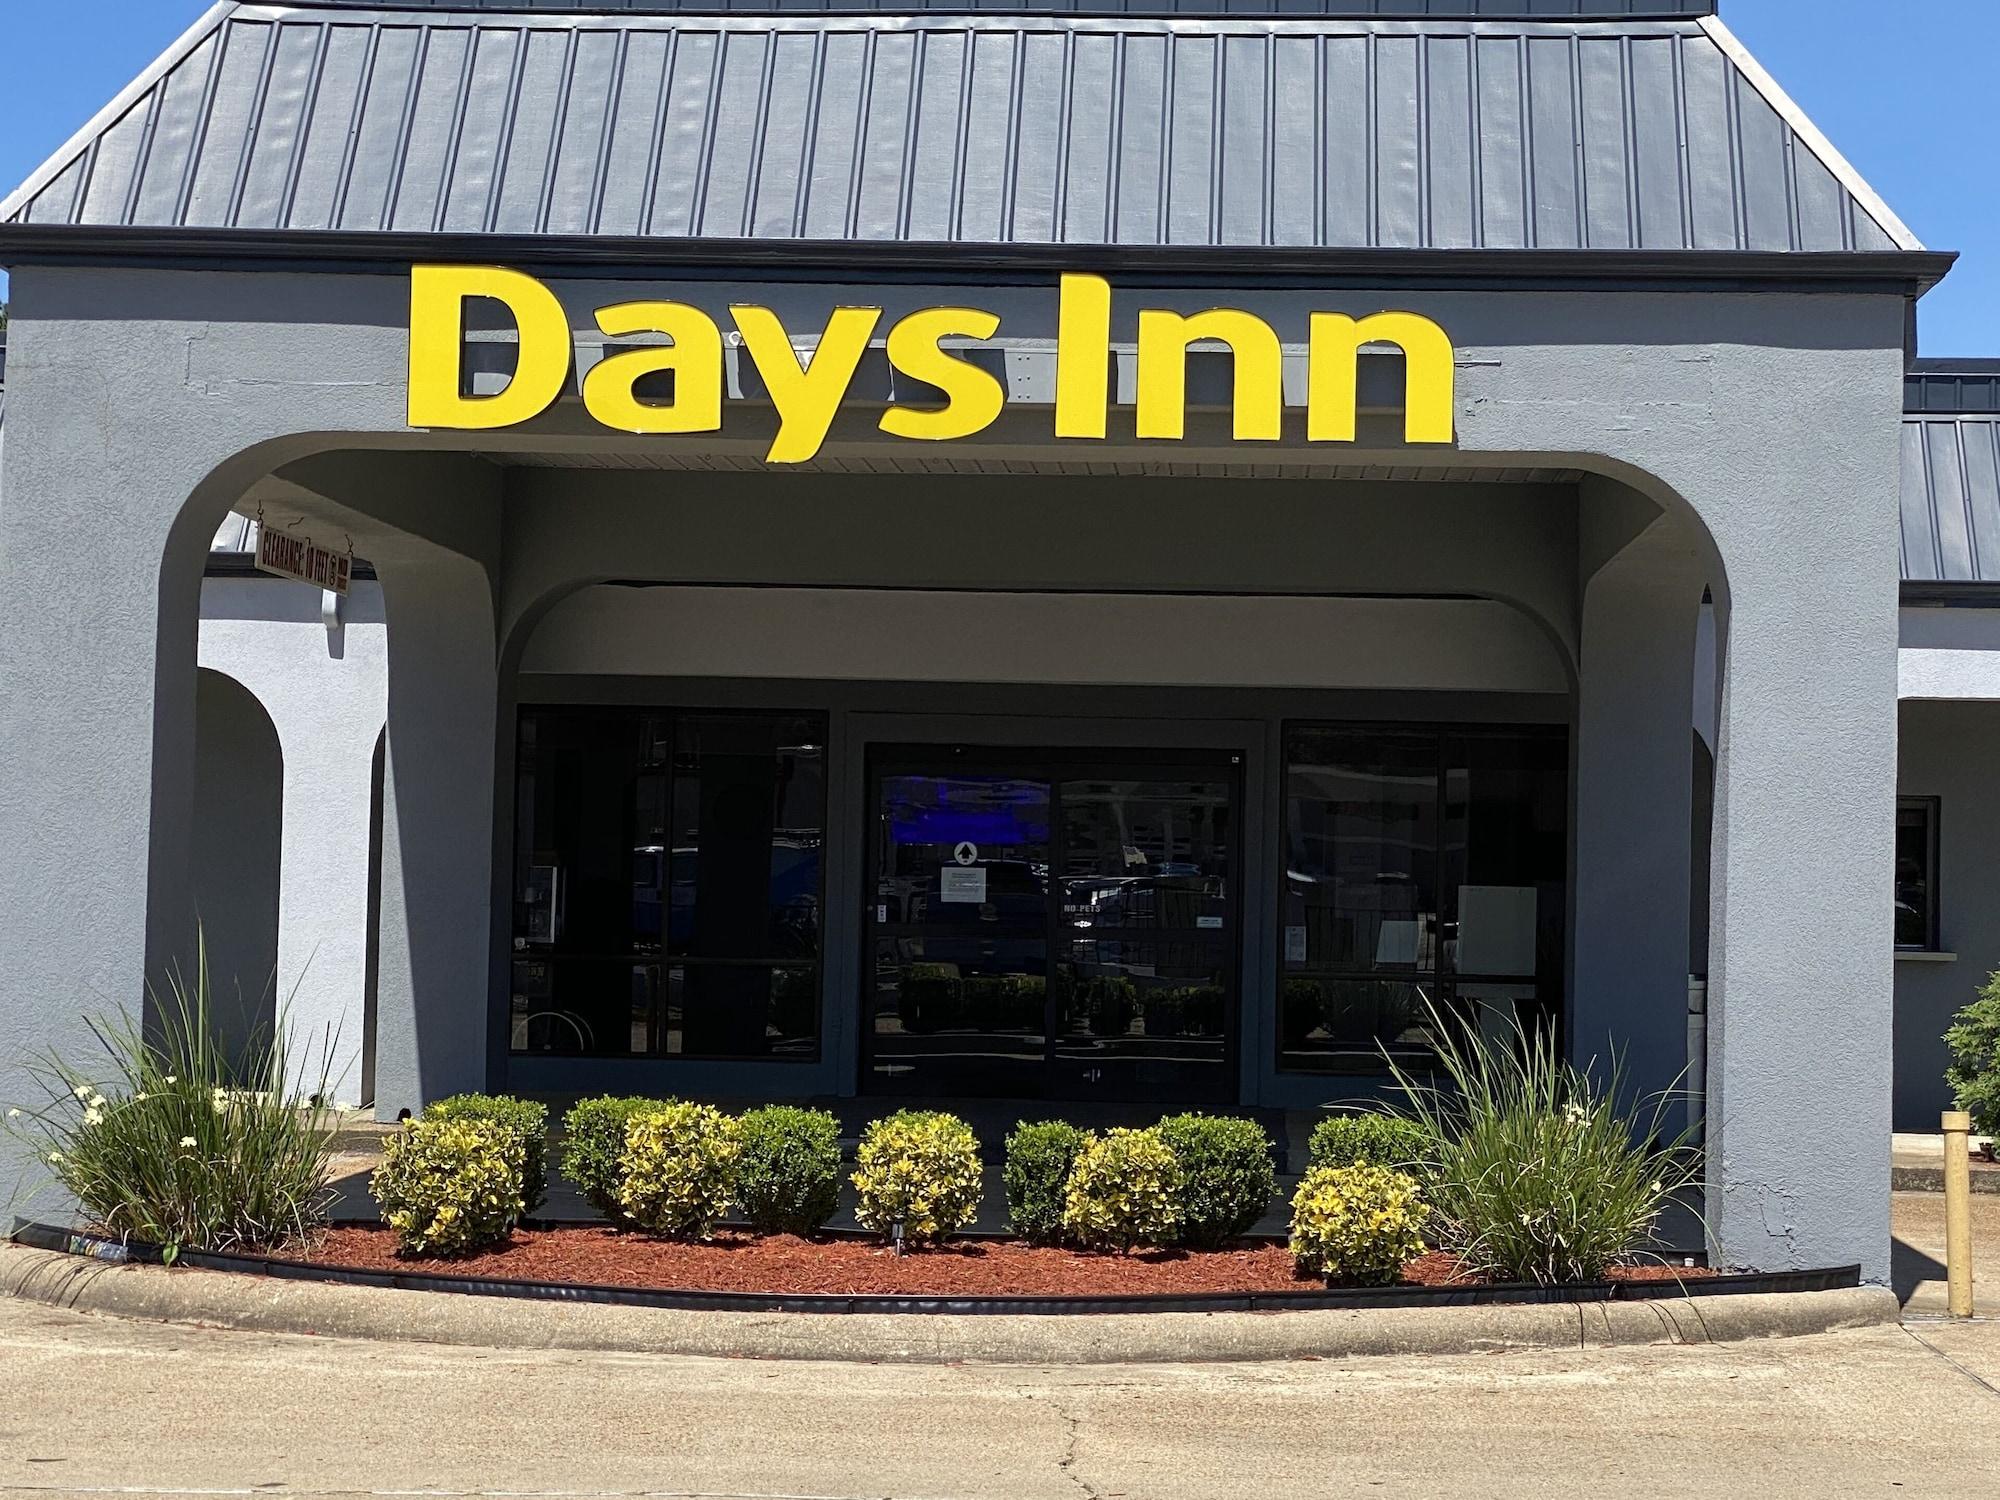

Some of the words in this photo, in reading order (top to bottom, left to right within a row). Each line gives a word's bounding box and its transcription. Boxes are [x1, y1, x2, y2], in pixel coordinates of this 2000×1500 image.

[407, 262, 1004, 464] Days
[1054, 271, 1454, 444] Inn
[314, 549, 328, 584] FEET
[1064, 904, 1076, 913] NO
[1080, 904, 1101, 913] PETS
